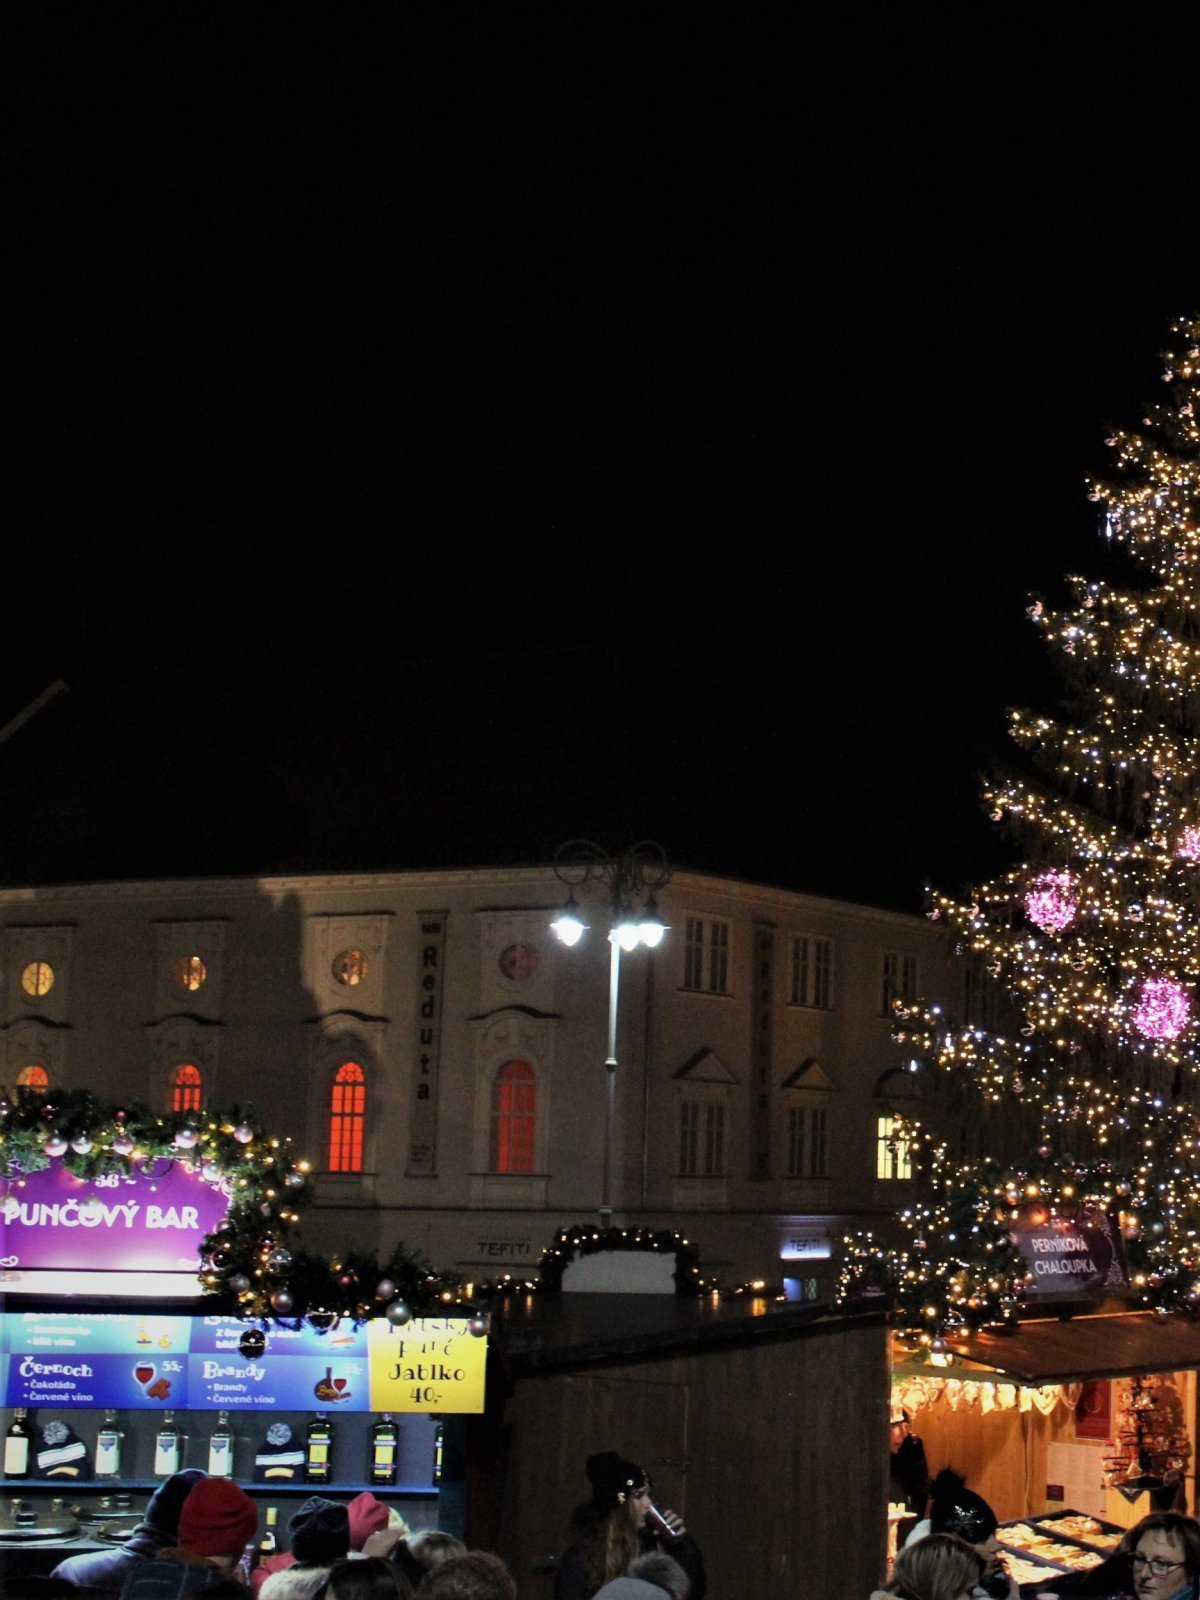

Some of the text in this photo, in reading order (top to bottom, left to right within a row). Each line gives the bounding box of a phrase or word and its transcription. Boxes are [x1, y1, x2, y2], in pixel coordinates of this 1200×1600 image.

[417, 945, 437, 1101] Reduta
[4, 1198, 199, 1229] PUNČOVÝ BAR
[1031, 1234, 1089, 1253] PERNÍKOVÁ
[1035, 1259, 1098, 1275] CHALOUPKA
[19, 1356, 93, 1377] Černoch
[202, 1360, 266, 1381] Brandy
[388, 1363, 466, 1381] Jablko
[29, 1390, 94, 1402] Červené víno
[213, 1383, 248, 1393] Brandy
[410, 1387, 443, 1404] 40,-
[213, 1393, 276, 1404] Červené víno
